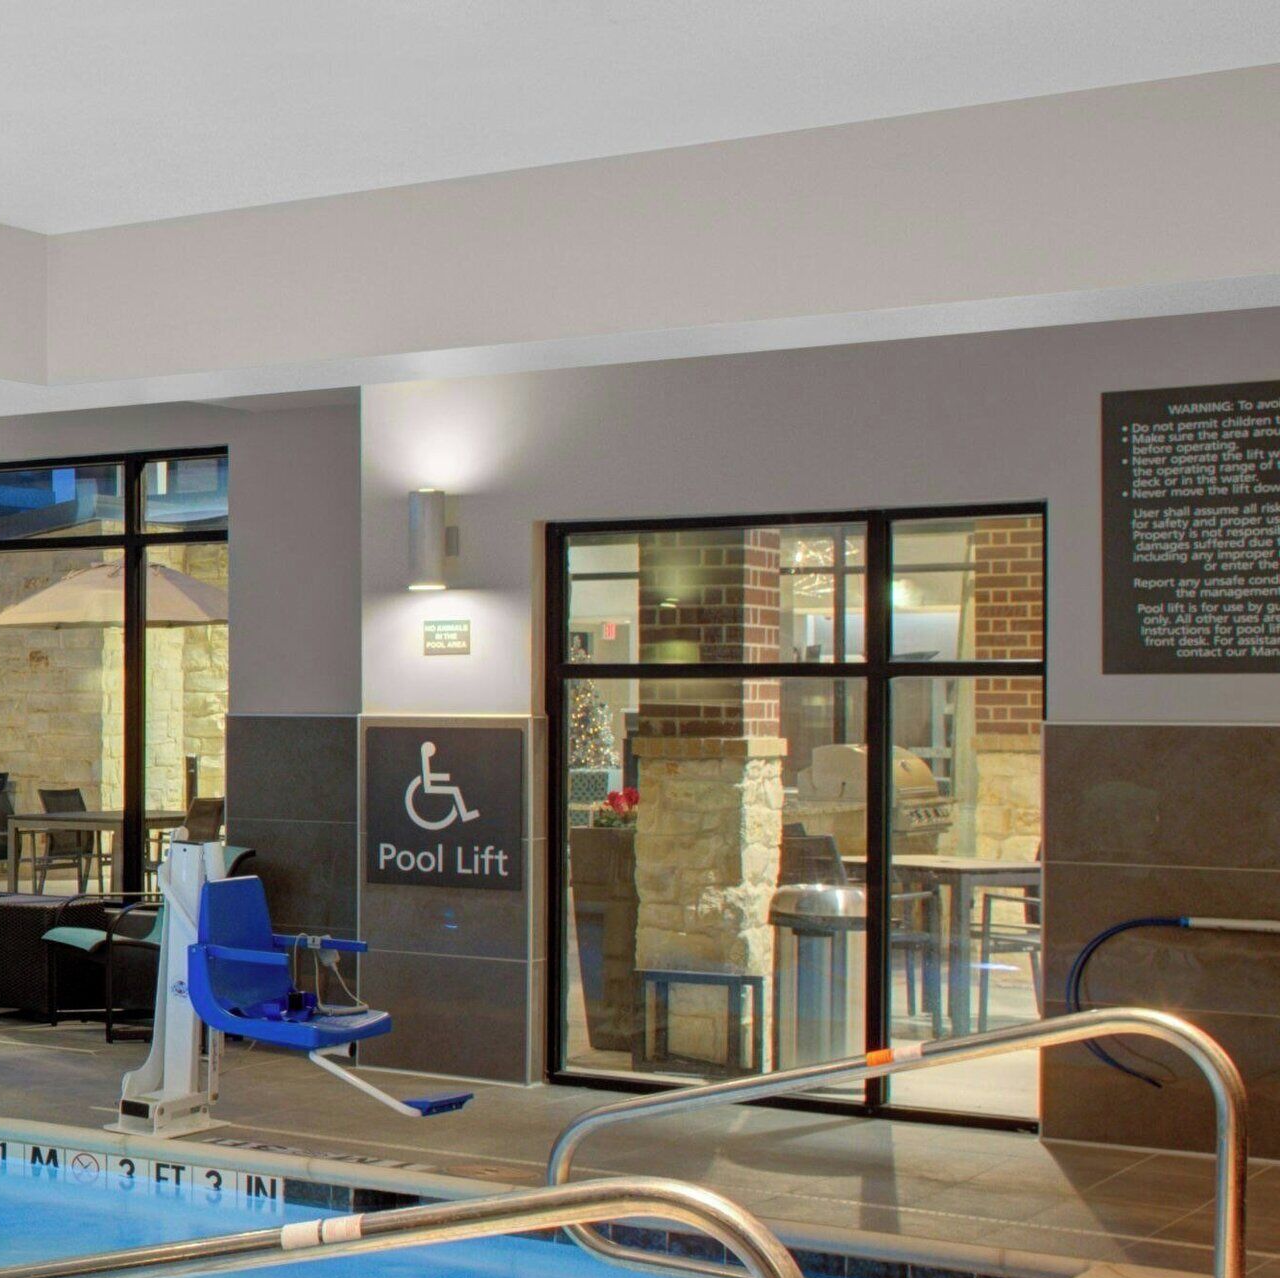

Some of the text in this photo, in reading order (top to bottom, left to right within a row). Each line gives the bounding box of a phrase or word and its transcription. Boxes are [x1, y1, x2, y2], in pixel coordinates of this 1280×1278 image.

[1168, 401, 1234, 414] WARNING:
[1238, 400, 1253, 410] To
[1132, 423, 1149, 433] Do
[1153, 422, 1174, 432] not
[1177, 418, 1218, 432] permit
[1222, 416, 1271, 428] children
[1132, 434, 1165, 443] Make
[1168, 432, 1194, 442] sure
[1198, 430, 1218, 440] the
[1222, 429, 1249, 438] area
[1133, 441, 1239, 455] before operating.
[1132, 457, 1166, 465] Never
[1170, 454, 1218, 465] operate
[1222, 451, 1242, 461] the
[1247, 449, 1264, 459] lift
[1133, 466, 1152, 476] the
[1157, 463, 1216, 477] operating
[1219, 463, 1255, 474] range
[1260, 459, 1273, 470] of
[1132, 473, 1259, 488] deck or in the water.
[1132, 489, 1166, 498] Never
[1171, 488, 1204, 497] move
[1208, 485, 1228, 495] the
[1232, 483, 1249, 494] lift
[1134, 509, 1160, 518] User
[1164, 506, 1190, 517] shall
[1194, 506, 1239, 515] assume
[1243, 504, 1257, 514] all
[1132, 519, 1148, 528] for
[1152, 518, 1189, 529] safety
[1192, 516, 1215, 527] and
[1220, 516, 1261, 528] proper
[1133, 530, 1185, 541] Property
[1189, 529, 1198, 538] is
[1202, 528, 1223, 537] not
[1136, 537, 1273, 552] damages suffered due
[1133, 549, 1275, 563] including any improper
[1204, 558, 1280, 571] or enter the
[1134, 578, 1175, 589] Report
[1178, 578, 1201, 588] any
[1204, 575, 1245, 586] unsafe
[1176, 588, 1195, 598] the
[1138, 604, 1164, 613] Pool
[1168, 604, 1185, 613] lift
[1189, 603, 1197, 612] is
[1202, 603, 1219, 613] for
[1248, 602, 1263, 613] by
[1143, 615, 1171, 625] only.
[1175, 613, 1191, 623] All
[1196, 613, 1228, 623] other
[1233, 614, 1259, 623] uses
[1215, 625, 1232, 635] for
[1236, 625, 1264, 635] pool
[1145, 636, 1174, 646] front
[1178, 636, 1209, 646] desk.
[1214, 636, 1232, 645] For
[1176, 647, 1222, 657] contact
[1226, 647, 1247, 657] our
[378, 842, 508, 876] Pool Lift
[155, 1162, 186, 1186] FT
[246, 1175, 277, 1200] IN
